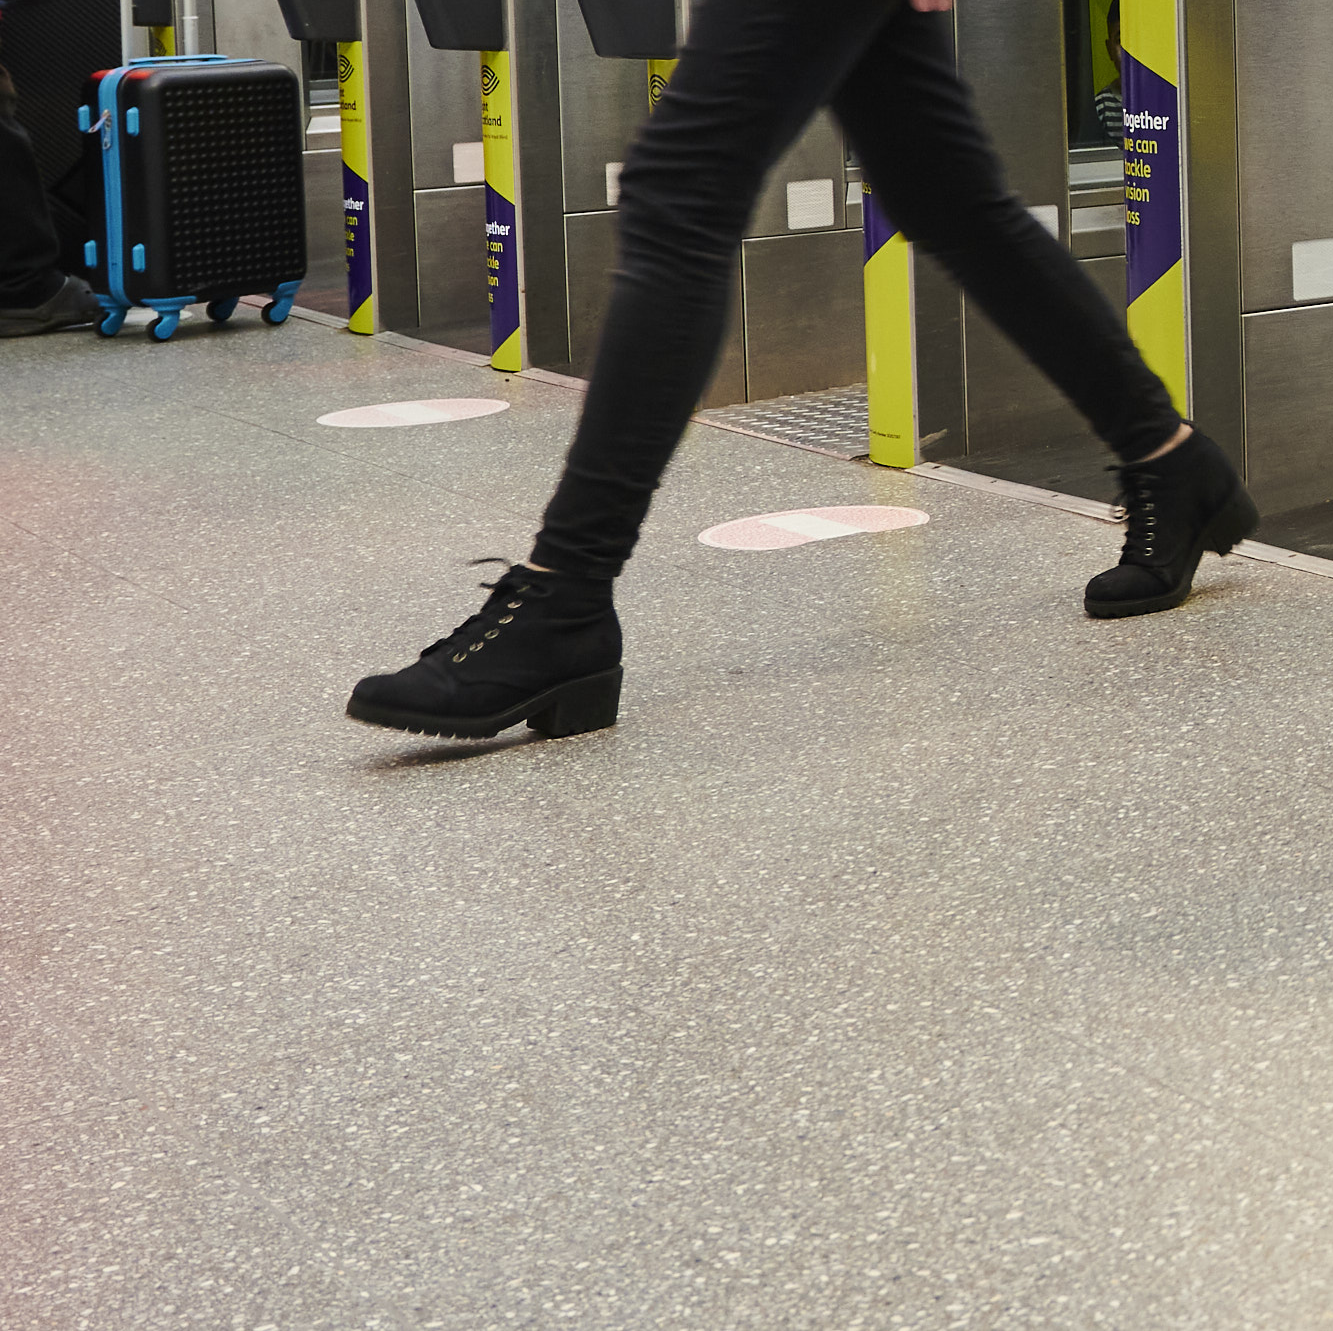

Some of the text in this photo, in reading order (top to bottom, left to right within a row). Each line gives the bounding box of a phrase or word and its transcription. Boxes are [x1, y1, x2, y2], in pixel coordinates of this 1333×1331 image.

[1122, 108, 1170, 133] Together
[1135, 138, 1158, 155] can
[485, 221, 511, 237] gether
